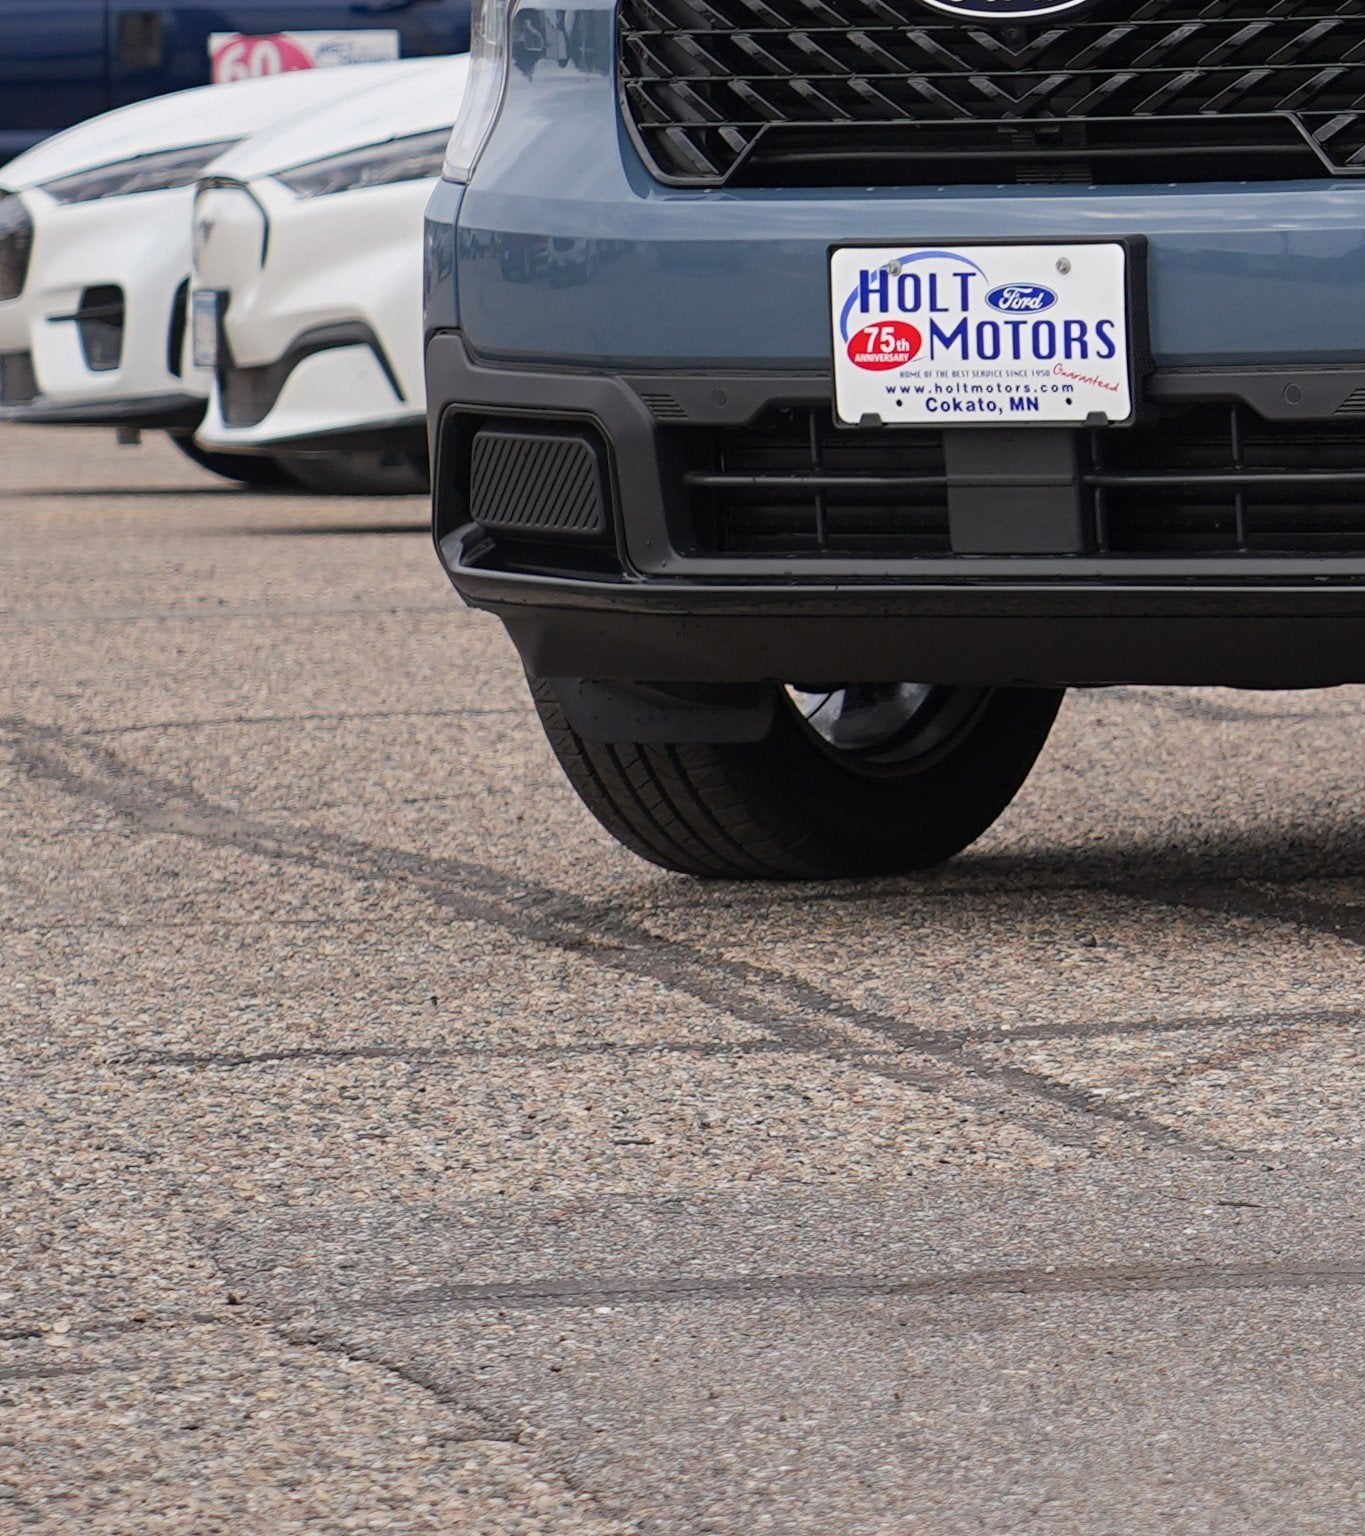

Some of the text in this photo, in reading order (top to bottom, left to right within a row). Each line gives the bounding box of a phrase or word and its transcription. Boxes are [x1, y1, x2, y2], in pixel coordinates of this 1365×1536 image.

[859, 269, 976, 313] HOLT
[999, 286, 1044, 310] Ford
[863, 326, 910, 354] 75th
[929, 316, 1116, 361] MOTORS
[854, 353, 909, 363] ANNIVERSARY
[886, 383, 1074, 394] www.holtmotors.com
[1053, 363, 1120, 392] Guaranteed
[926, 396, 1039, 415] Cokato, MN
